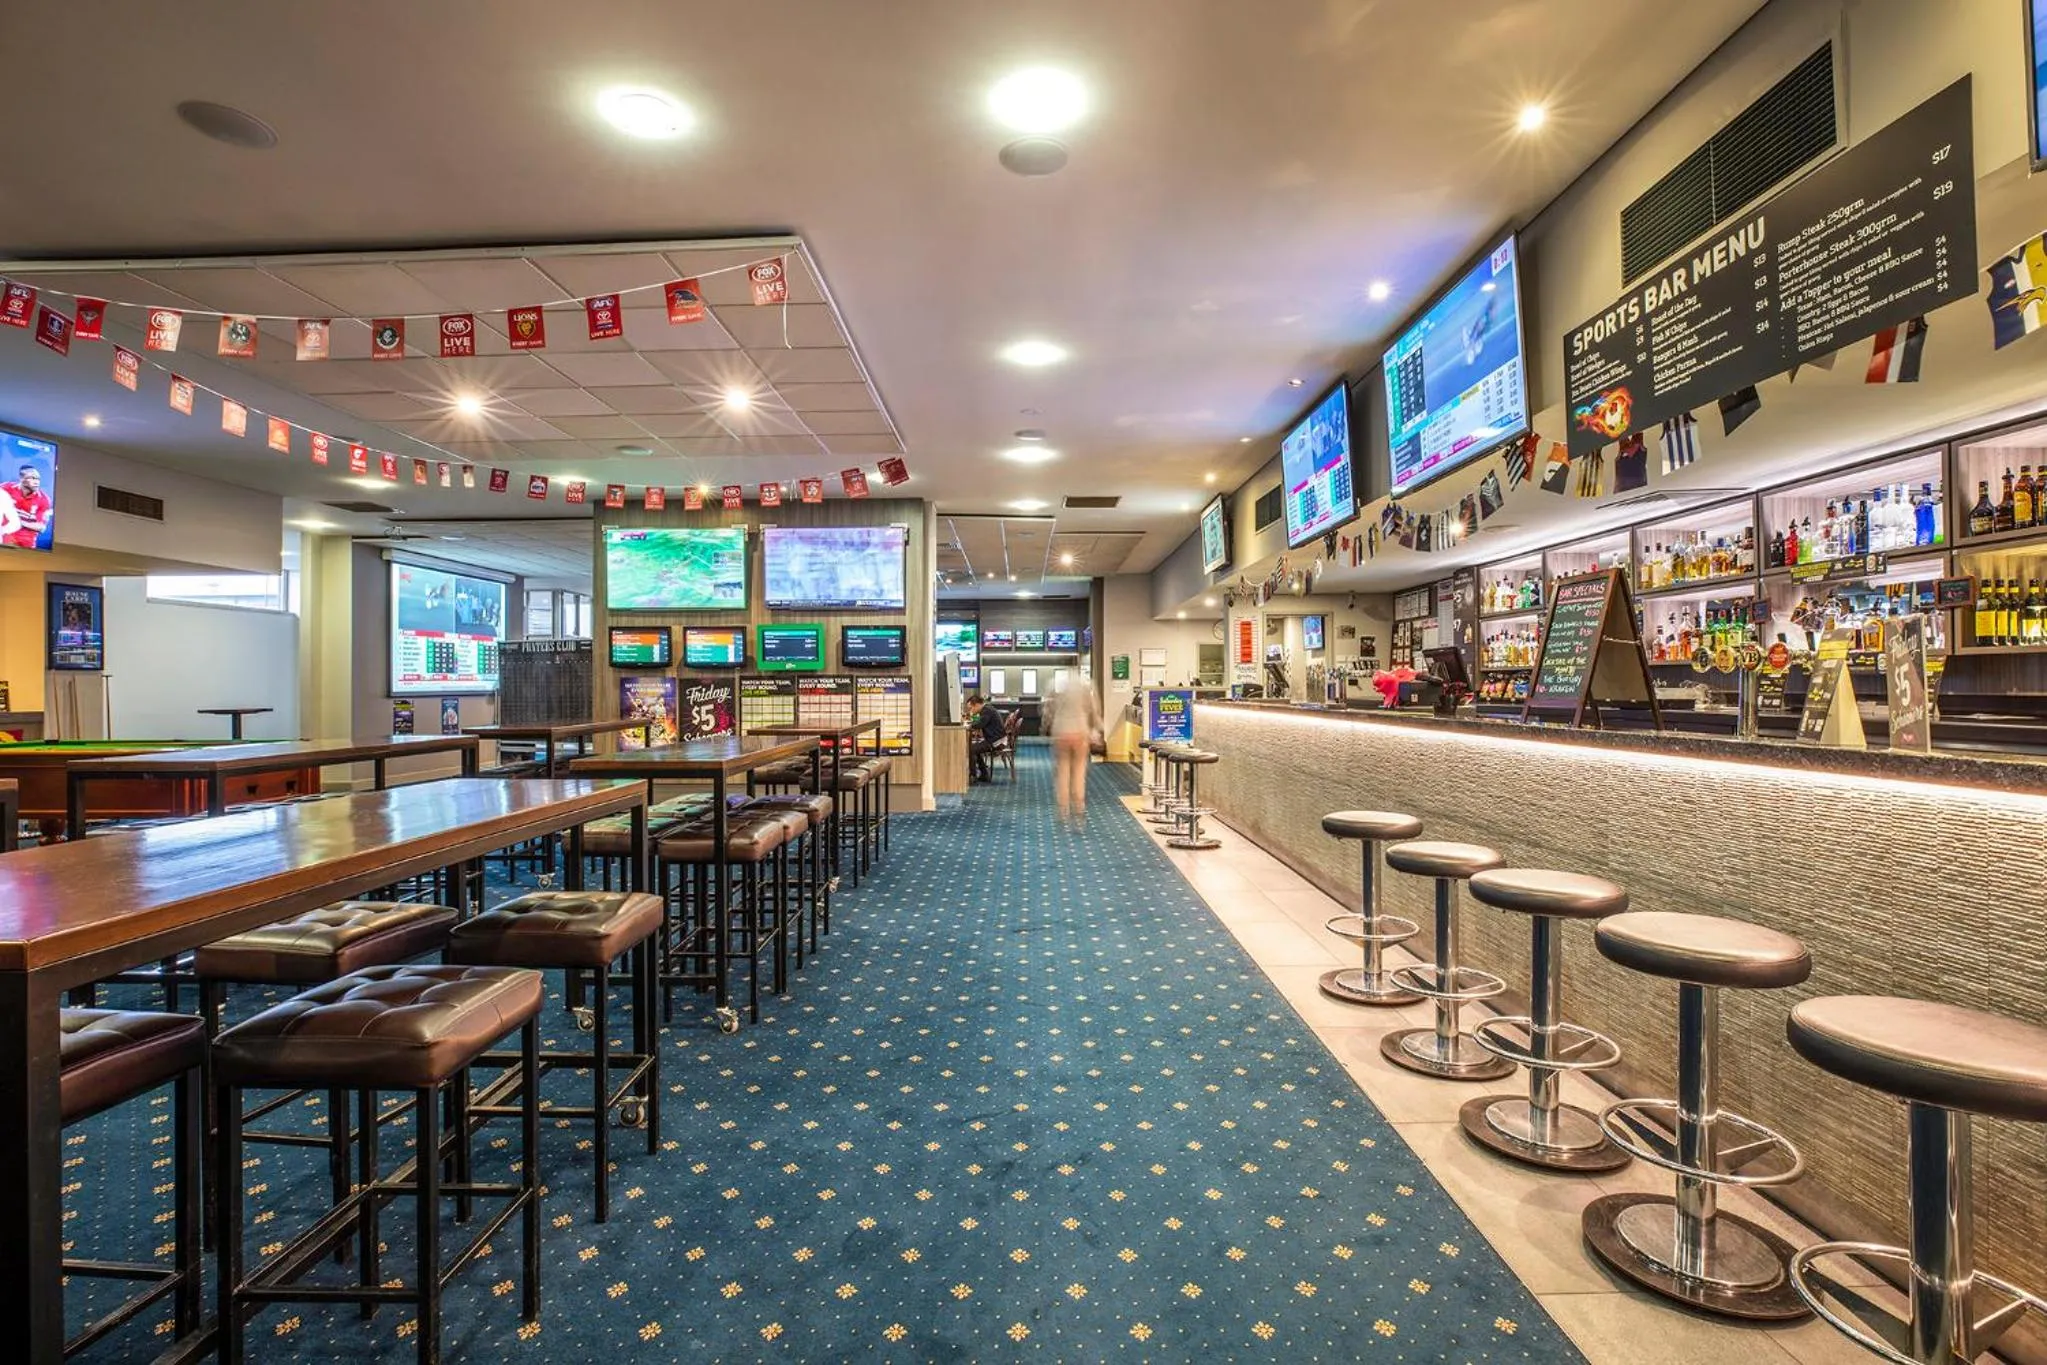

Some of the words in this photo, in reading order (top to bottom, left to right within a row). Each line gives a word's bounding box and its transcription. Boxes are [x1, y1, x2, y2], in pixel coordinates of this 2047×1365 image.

[1932, 144, 1951, 165] $17
[1933, 180, 1953, 200] $19
[1777, 235, 1801, 254] Rump
[1802, 218, 1826, 240] Steak
[1827, 198, 1865, 225] 250grm
[1778, 250, 1828, 283] Porterhouse
[1829, 234, 1856, 255] Steak
[1856, 214, 1897, 241] 300grm
[1935, 235, 1947, 247] $4
[1900, 247, 1923, 263] Sauce
[1935, 246, 1947, 258] $4
[1753, 253, 1767, 268] $13
[1936, 258, 1947, 270] $4
[757, 268, 775, 278] FOX
[1780, 295, 1797, 312] Add
[1797, 295, 1803, 303] a
[1802, 279, 1832, 300] Topper
[1832, 275, 1842, 285] to
[1843, 262, 1866, 283] your
[1867, 247, 1892, 268] meal
[1936, 270, 1948, 281] $4
[756, 282, 784, 294] LIVE
[1573, 297, 1640, 355] SPORTS
[1644, 268, 1687, 313] BAR
[1693, 217, 1765, 284] MENU
[1754, 275, 1768, 290] $13
[1894, 287, 1912, 300] sour
[1911, 277, 1935, 292] cream
[1937, 281, 1949, 293] $4
[1848, 285, 1869, 299] Bacon
[594, 300, 613, 308] AFL
[1673, 302, 1685, 313] the
[1684, 295, 1697, 307] Day
[1755, 297, 1769, 312] $14
[513, 312, 538, 322] LIONS
[448, 320, 465, 330] FOX
[1756, 320, 1770, 334] $14
[150, 331, 175, 340] LIVE
[1652, 332, 1665, 345] Fish
[1669, 321, 1688, 335] Chips
[444, 337, 471, 347] LIVE
[1652, 347, 1677, 364] Bangers
[1682, 334, 1699, 349] Mash
[444, 346, 471, 355] HERE
[1653, 367, 1676, 383] Chicken
[1676, 357, 1697, 373] Parma
[1895, 663, 1911, 707] $5
[686, 684, 732, 705] Friday
[692, 704, 716, 731] $5
